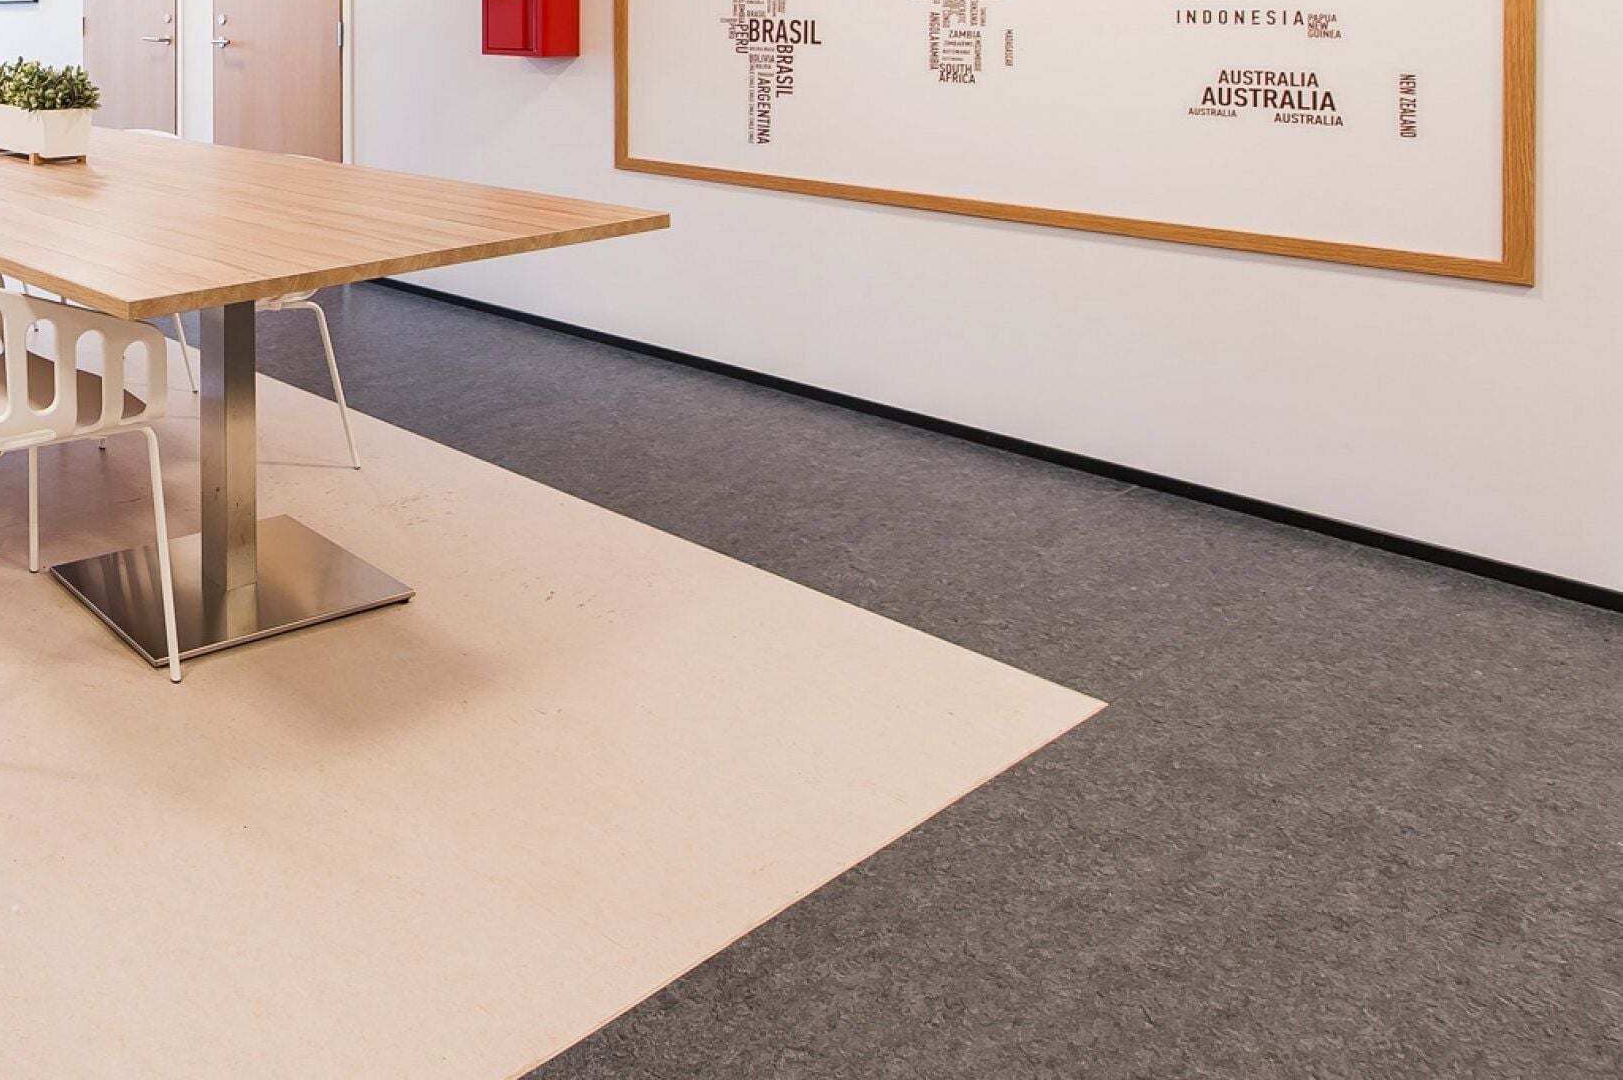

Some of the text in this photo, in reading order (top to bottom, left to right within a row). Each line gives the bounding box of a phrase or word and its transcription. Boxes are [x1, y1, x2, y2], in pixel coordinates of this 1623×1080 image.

[1176, 9, 1304, 26] INDONESIA
[1307, 13, 1337, 23] PAPUA
[749, 18, 822, 45] BRASIL
[1307, 21, 1328, 30] NEW
[736, 24, 749, 54] PERU
[948, 30, 981, 39] ZAMBIA
[1307, 29, 1342, 39] GUINEA
[776, 45, 793, 97] BRASIL
[939, 64, 972, 74] SOUTH
[938, 72, 975, 84] AFRICA
[1218, 69, 1320, 88] AUSTRALIA
[1201, 87, 1337, 112] AUSTRALIA
[1400, 74, 1417, 138] NEW ZEALAND
[757, 77, 771, 144] ARGENTINA
[1187, 107, 1237, 118] AUSTRALIA
[1274, 113, 1344, 126] AUSTRALIA
